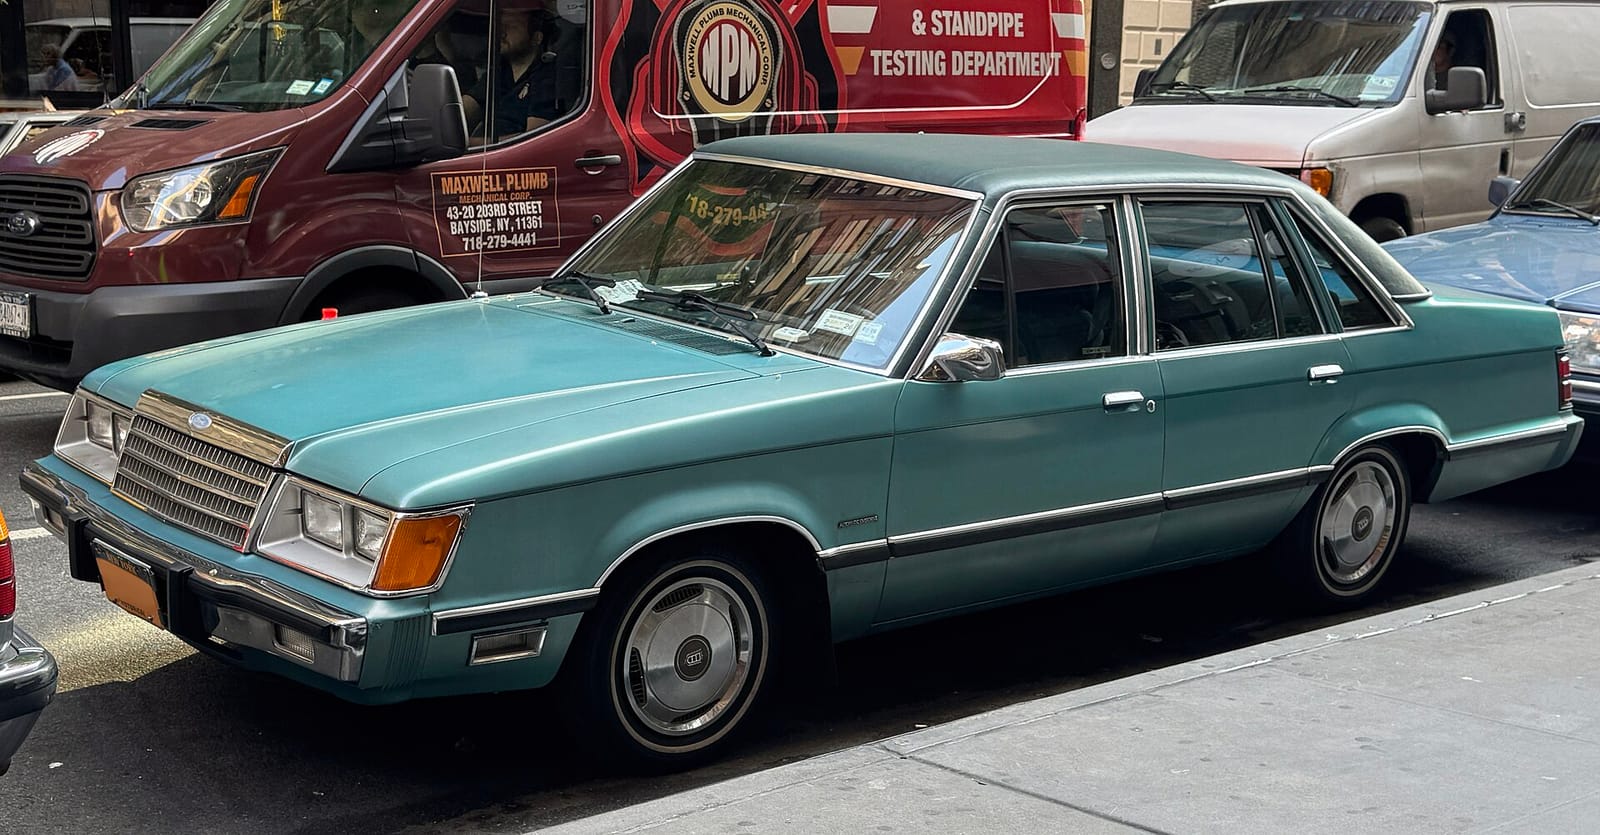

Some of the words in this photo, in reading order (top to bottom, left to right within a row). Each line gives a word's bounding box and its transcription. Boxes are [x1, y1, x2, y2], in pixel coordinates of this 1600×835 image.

[911, 9, 926, 36] &
[931, 10, 1024, 37] STANDPIPE
[688, 28, 701, 78] MAXWELL
[699, 8, 724, 28] PLUMB
[726, 8, 767, 54] MECHANICAL
[702, 23, 757, 101] MPM
[870, 50, 946, 76] TESTING
[952, 50, 1061, 76] DEPARTMENT
[441, 174, 504, 195] MAXWELL
[506, 172, 548, 191] PLUMB
[510, 191, 533, 201] CORP.
[446, 205, 475, 220] 43-20
[476, 203, 507, 218] 203RD
[508, 200, 543, 216] STREET
[450, 218, 496, 235] BAYSIDE,
[515, 215, 543, 230] 11361
[462, 231, 537, 252] 718-279-4441
